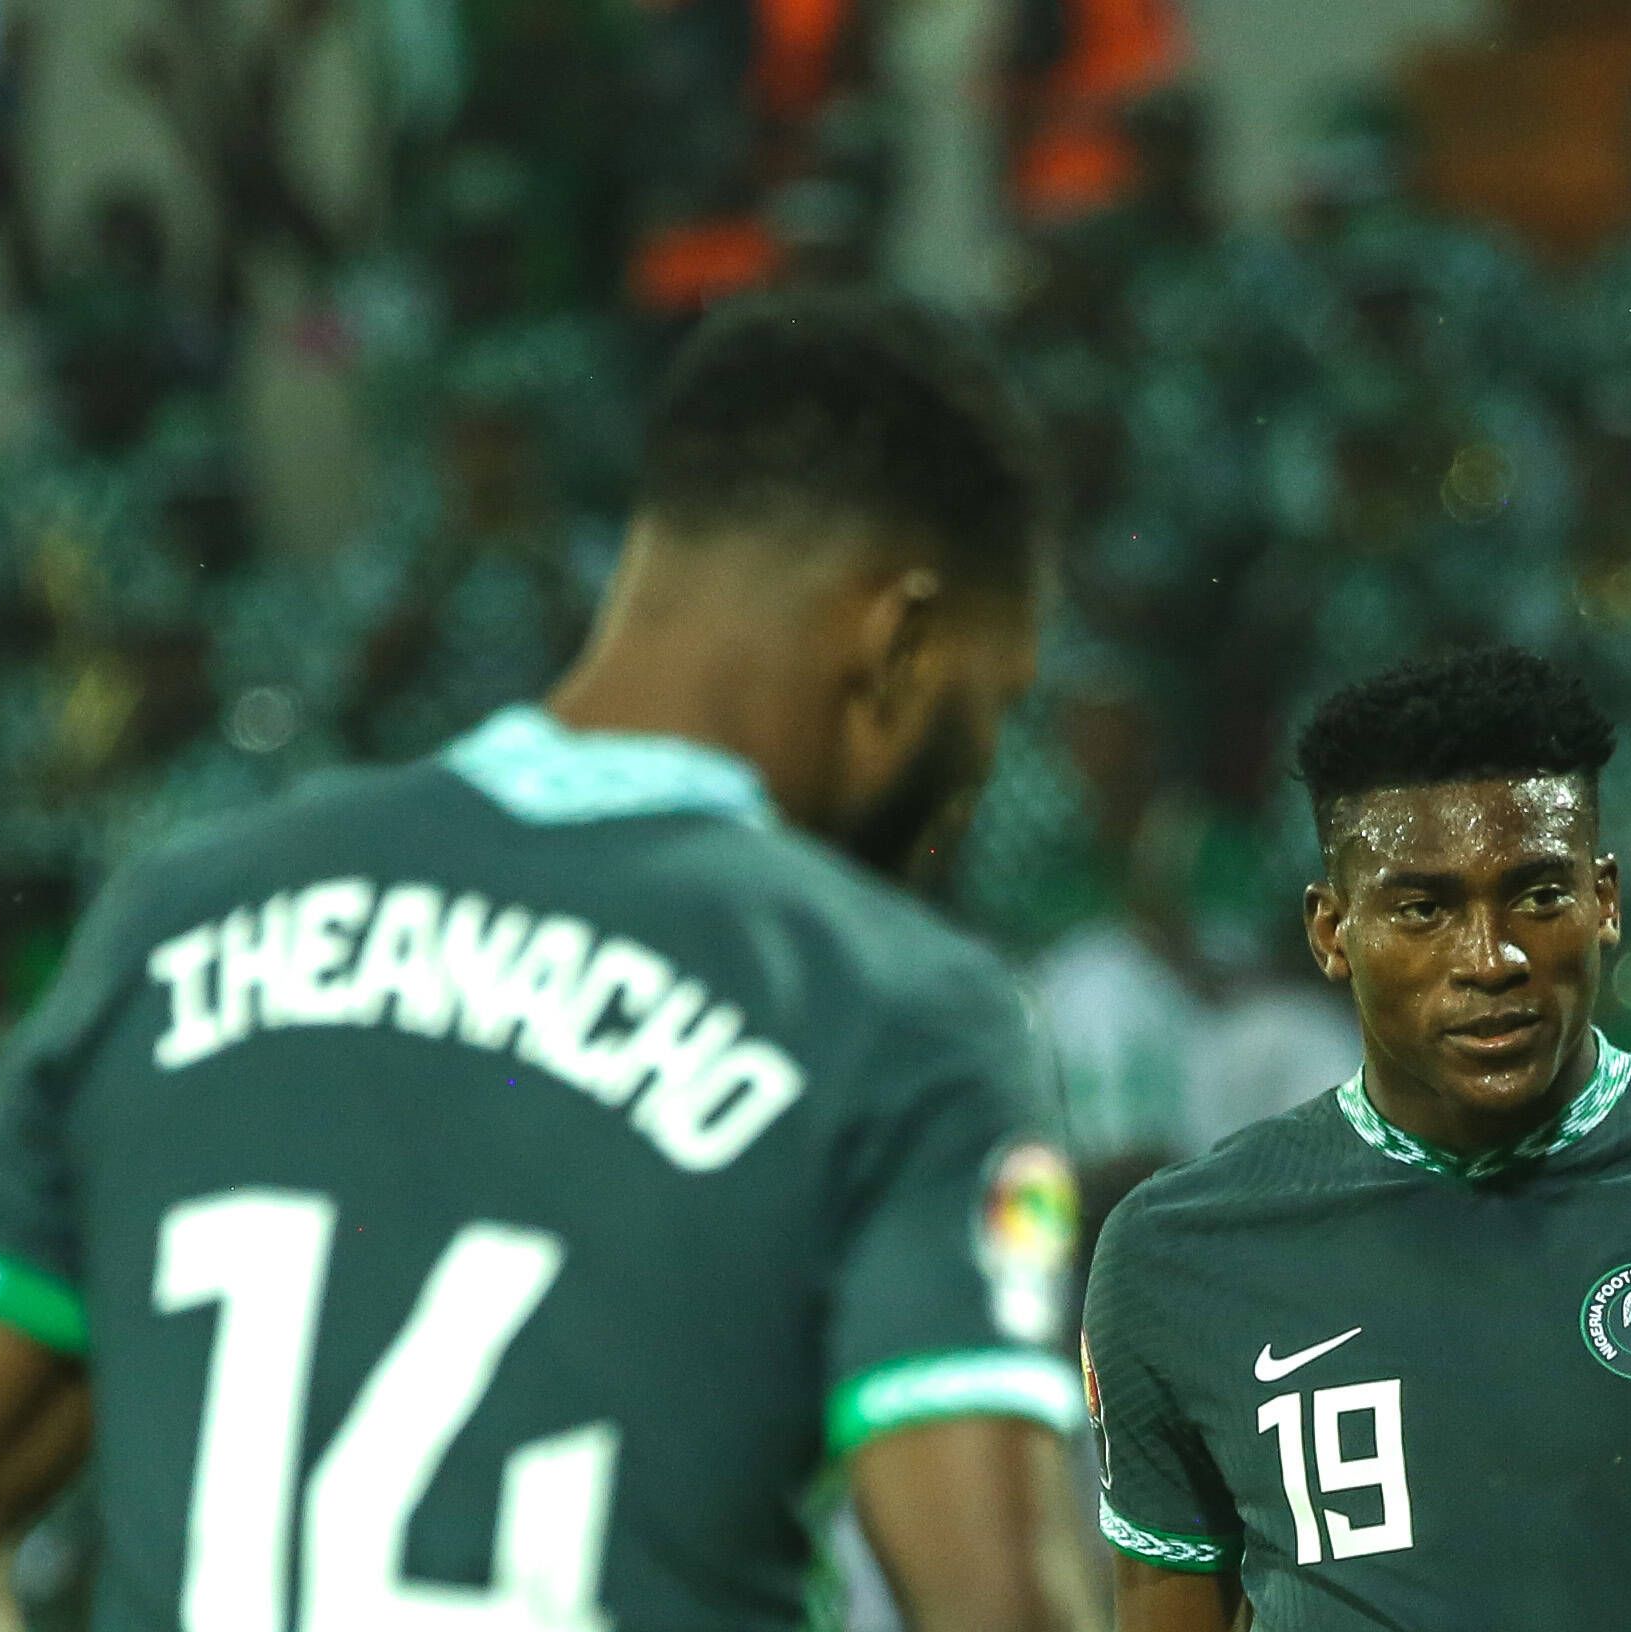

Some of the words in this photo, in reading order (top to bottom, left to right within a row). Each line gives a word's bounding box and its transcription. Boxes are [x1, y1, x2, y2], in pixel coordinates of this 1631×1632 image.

[148, 876, 805, 1170] IHEANACHO
[1588, 1304, 1618, 1360] NIGERIA
[1258, 1378, 1413, 1565] 19
